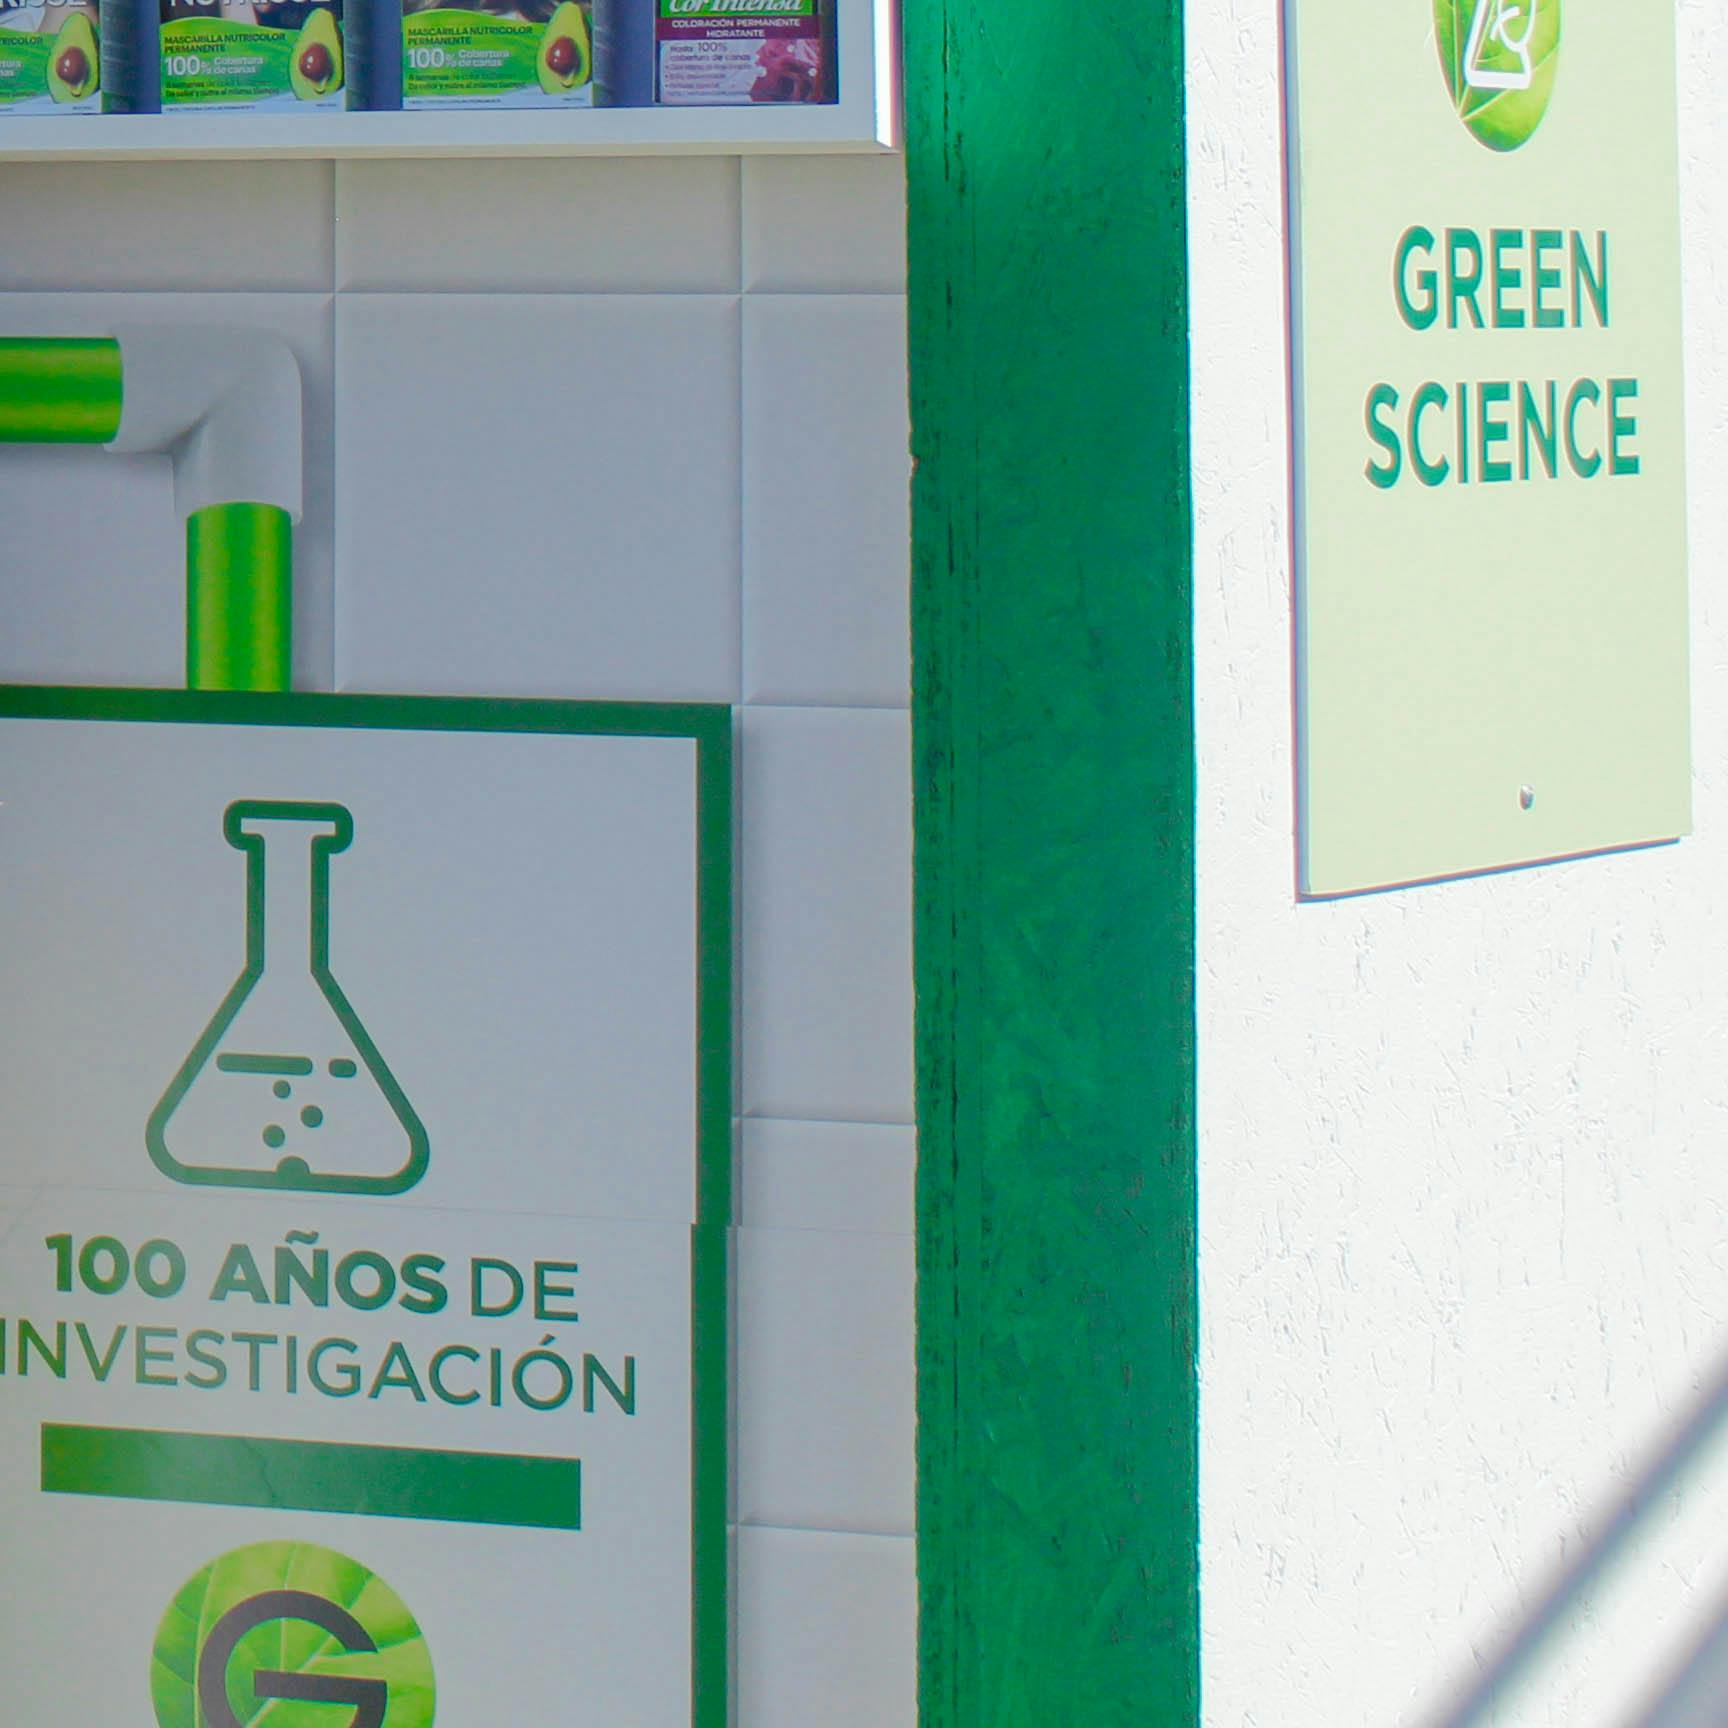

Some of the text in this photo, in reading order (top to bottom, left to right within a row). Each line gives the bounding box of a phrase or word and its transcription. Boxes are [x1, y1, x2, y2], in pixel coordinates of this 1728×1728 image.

[736, 18, 801, 28] PERMANENTE
[408, 26, 534, 37] MASCARILLA NUTRICOLOR
[706, 29, 766, 38] HIDRATANTE
[165, 33, 286, 44] MASCARILLA NUTRICOLOR
[165, 44, 226, 54] PERMANENTE
[1393, 225, 1609, 331] GREEN
[1364, 377, 1640, 489] SCIENCE
[45, 1229, 579, 1322] 100 AÑOS DE
[197, 1589, 388, 1728] G
